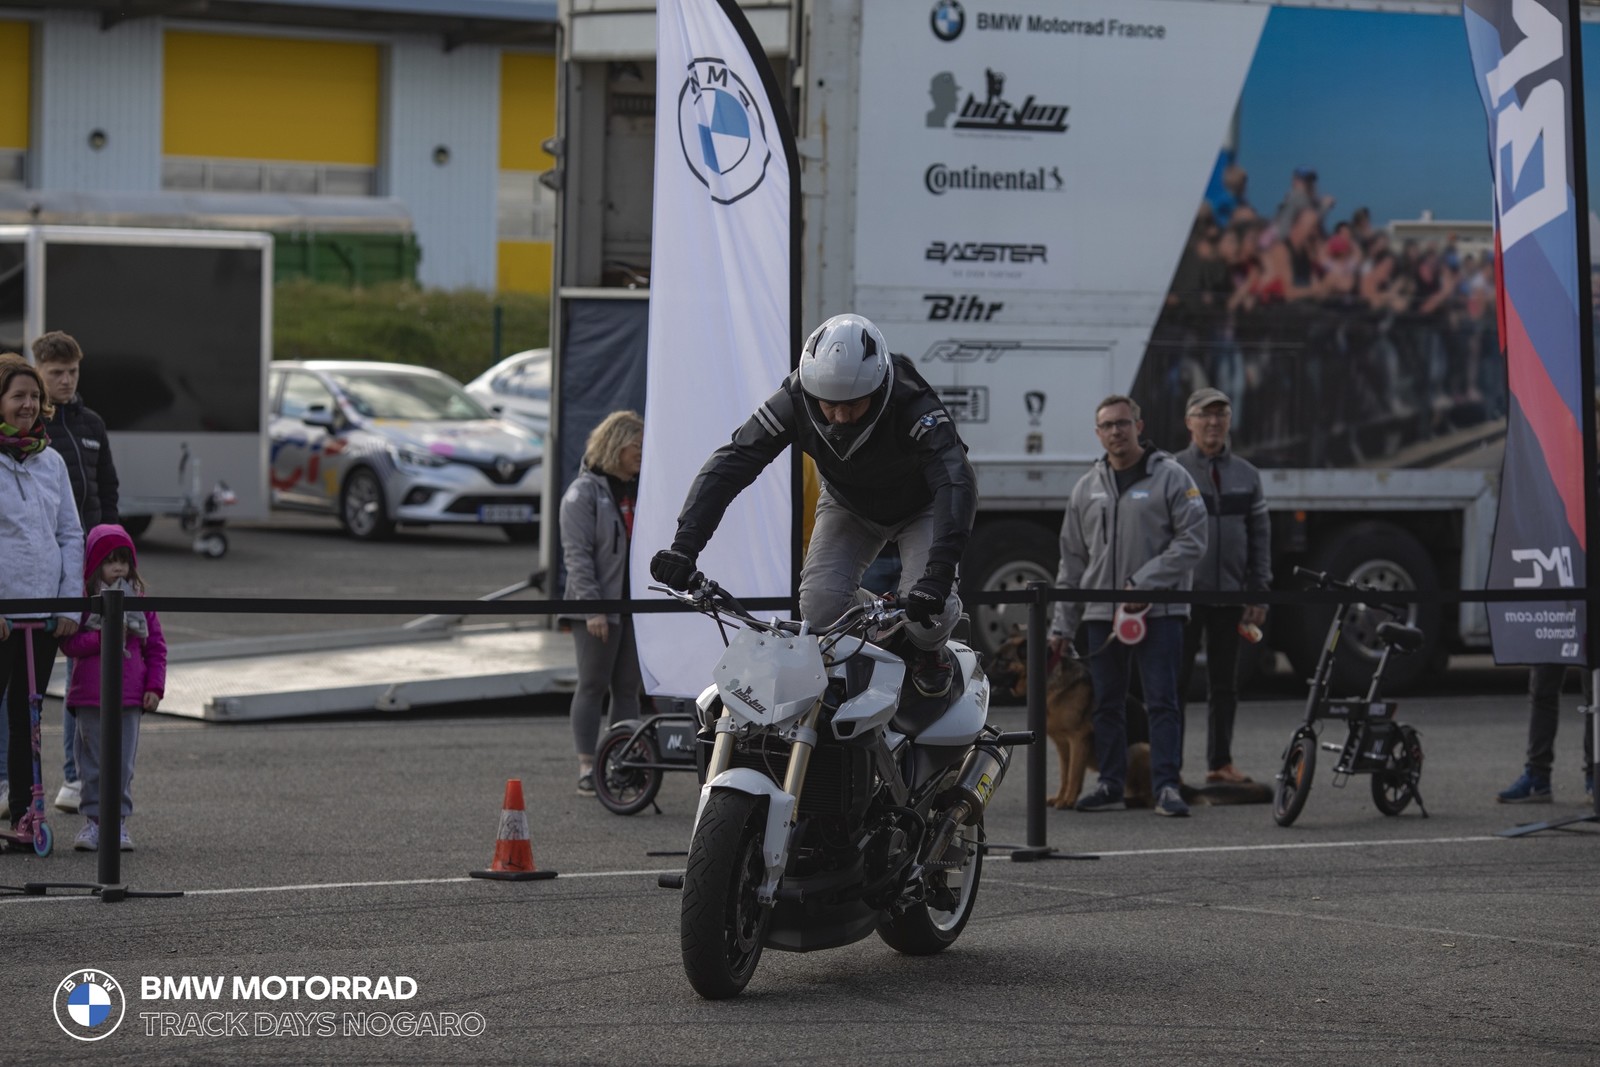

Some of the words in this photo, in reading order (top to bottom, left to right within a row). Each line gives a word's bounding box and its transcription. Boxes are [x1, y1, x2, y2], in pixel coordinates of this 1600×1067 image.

[976, 12, 1023, 32] BMW
[1026, 15, 1105, 36] Motorrad
[1107, 18, 1167, 39] France
[924, 162, 1045, 196] Continental
[924, 241, 1048, 264] BAGSTER
[923, 294, 1004, 321] Bihr
